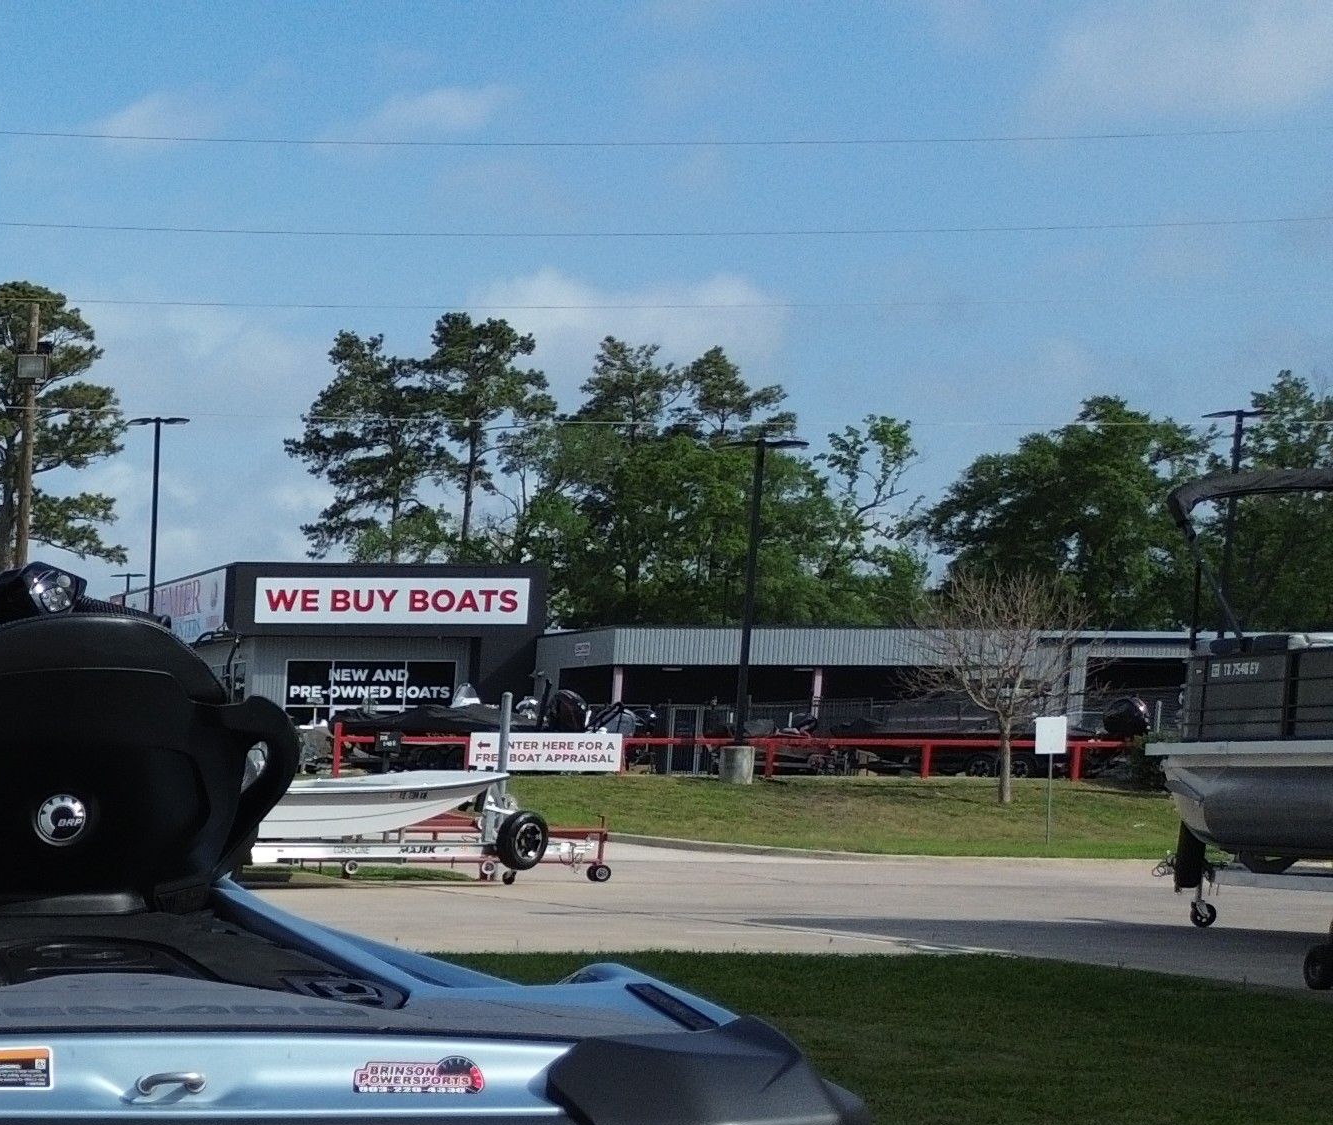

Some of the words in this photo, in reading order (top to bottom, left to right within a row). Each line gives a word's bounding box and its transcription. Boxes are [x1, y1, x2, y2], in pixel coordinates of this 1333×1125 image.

[265, 589, 320, 612] WE
[330, 589, 399, 612] BUY
[408, 589, 519, 612] BOATS
[329, 669, 368, 681] NEW
[372, 669, 409, 682] AND
[289, 685, 392, 698] PRE-OWNED
[396, 686, 450, 699] BOATS
[507, 741, 538, 750] NTER
[542, 741, 574, 751] HERE
[578, 741, 602, 751] FOR
[606, 741, 615, 751] A
[475, 754, 499, 762] FRE
[509, 754, 541, 762] BOAT
[545, 754, 615, 763] APPRAISAL
[369, 1066, 436, 1075] BRINSON
[359, 1074, 470, 1085] POWERSPORTS
